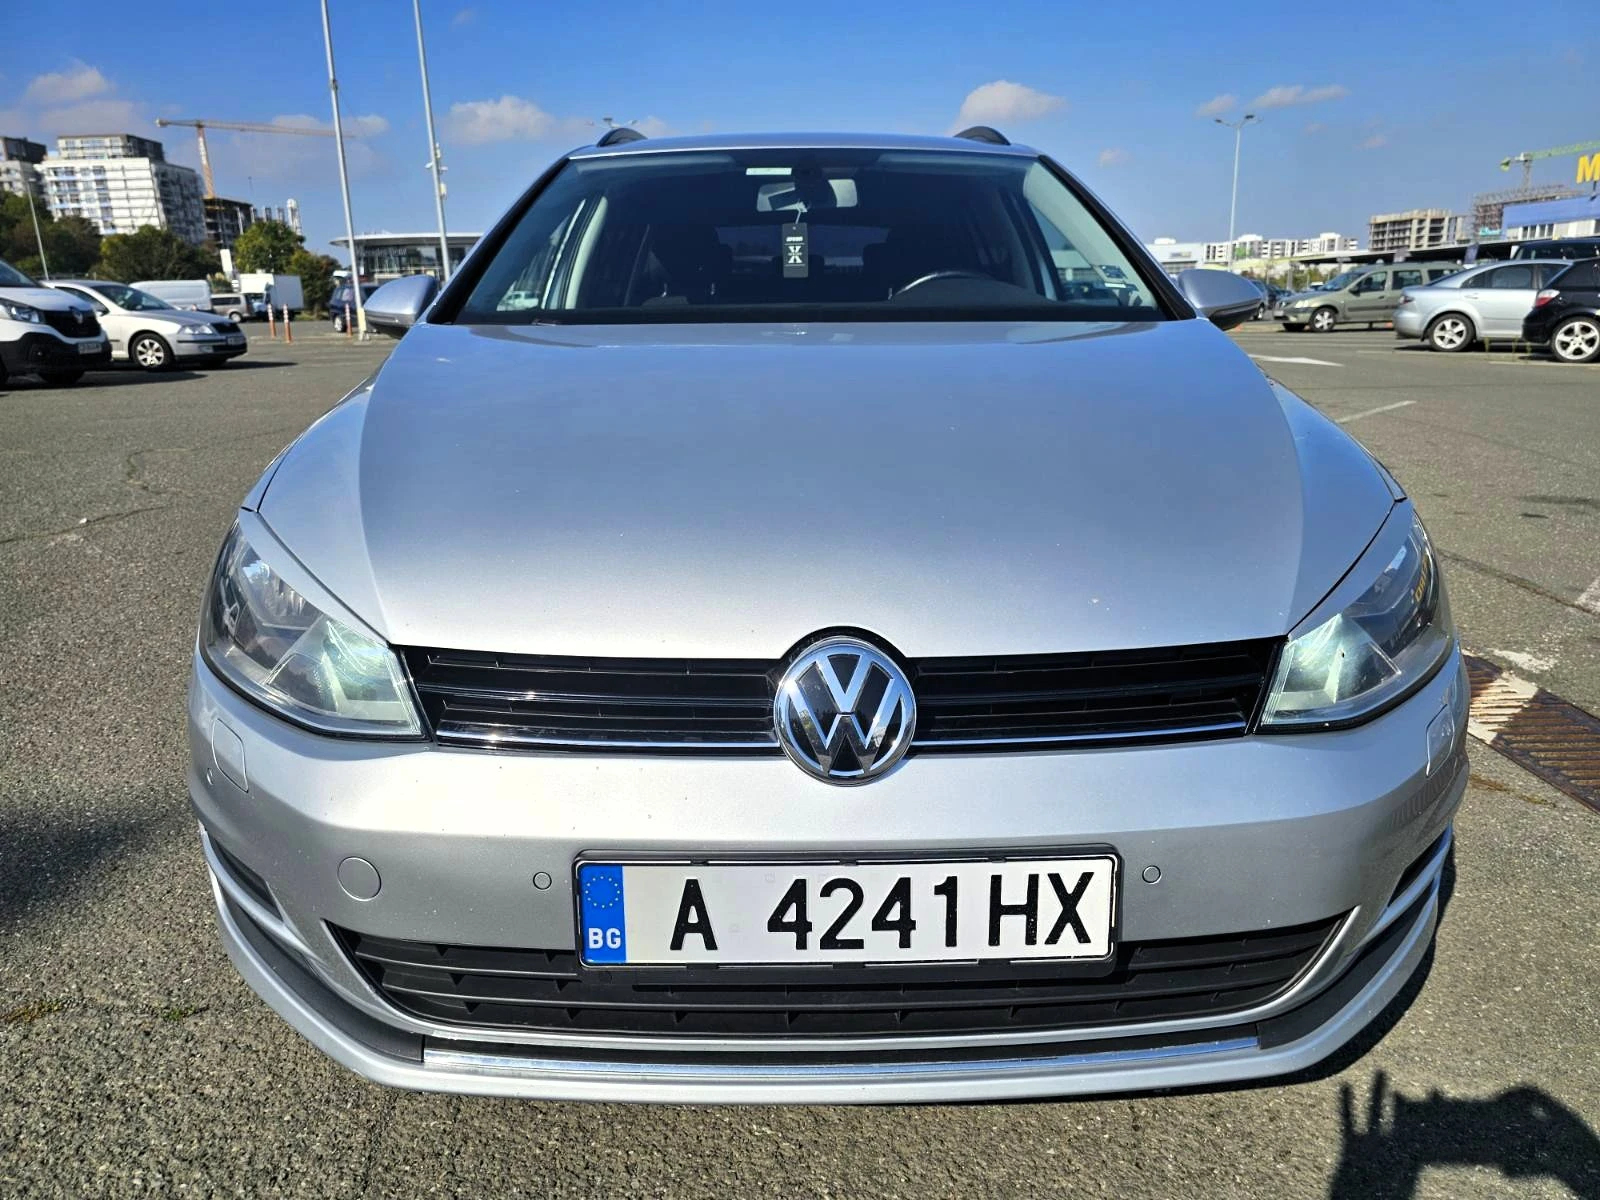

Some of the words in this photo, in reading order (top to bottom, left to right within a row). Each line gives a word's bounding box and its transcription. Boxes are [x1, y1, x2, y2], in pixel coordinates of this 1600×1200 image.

[669, 878, 718, 951] A
[767, 876, 958, 951] 4241
[987, 871, 1095, 947] HX
[588, 927, 622, 950] BG
